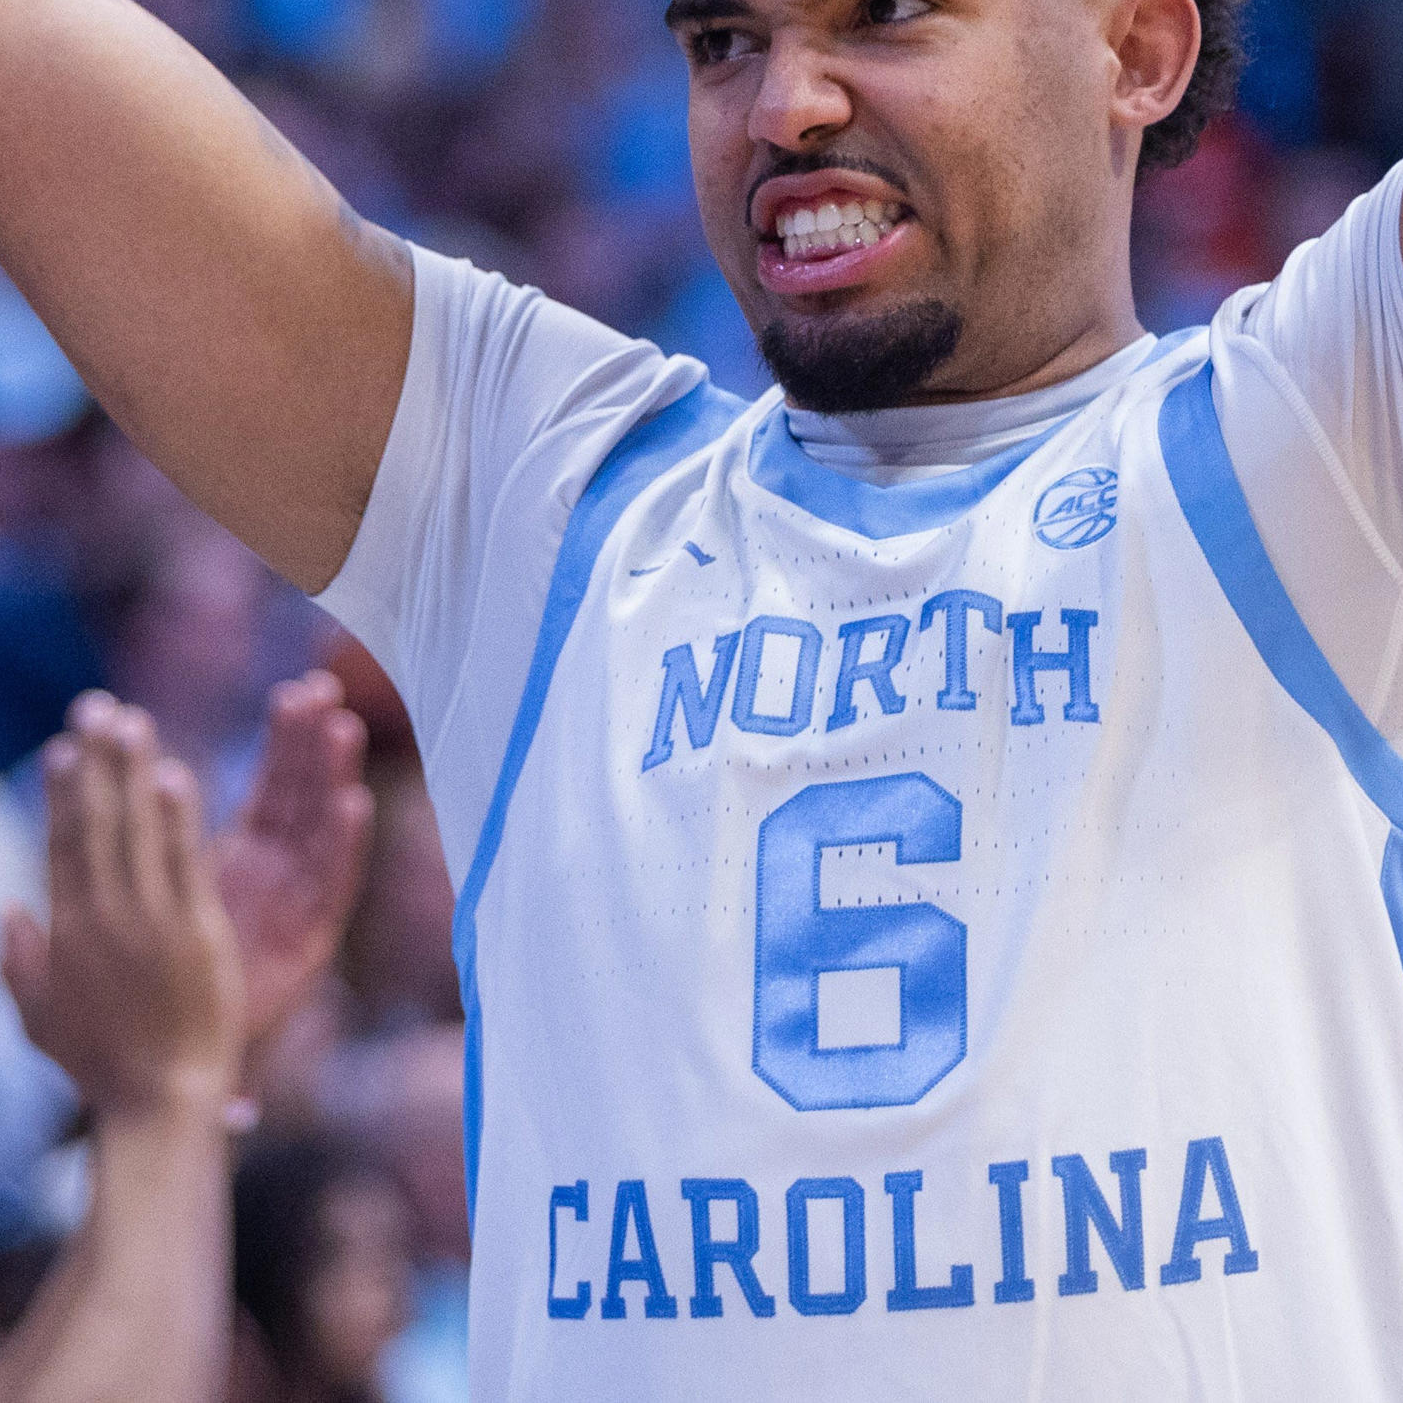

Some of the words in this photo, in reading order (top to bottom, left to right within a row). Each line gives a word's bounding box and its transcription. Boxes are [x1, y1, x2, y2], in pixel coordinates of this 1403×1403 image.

[640, 588, 1102, 773] NORTH
[752, 771, 968, 1112] 6
[547, 1135, 1259, 1321] CAROLINA
